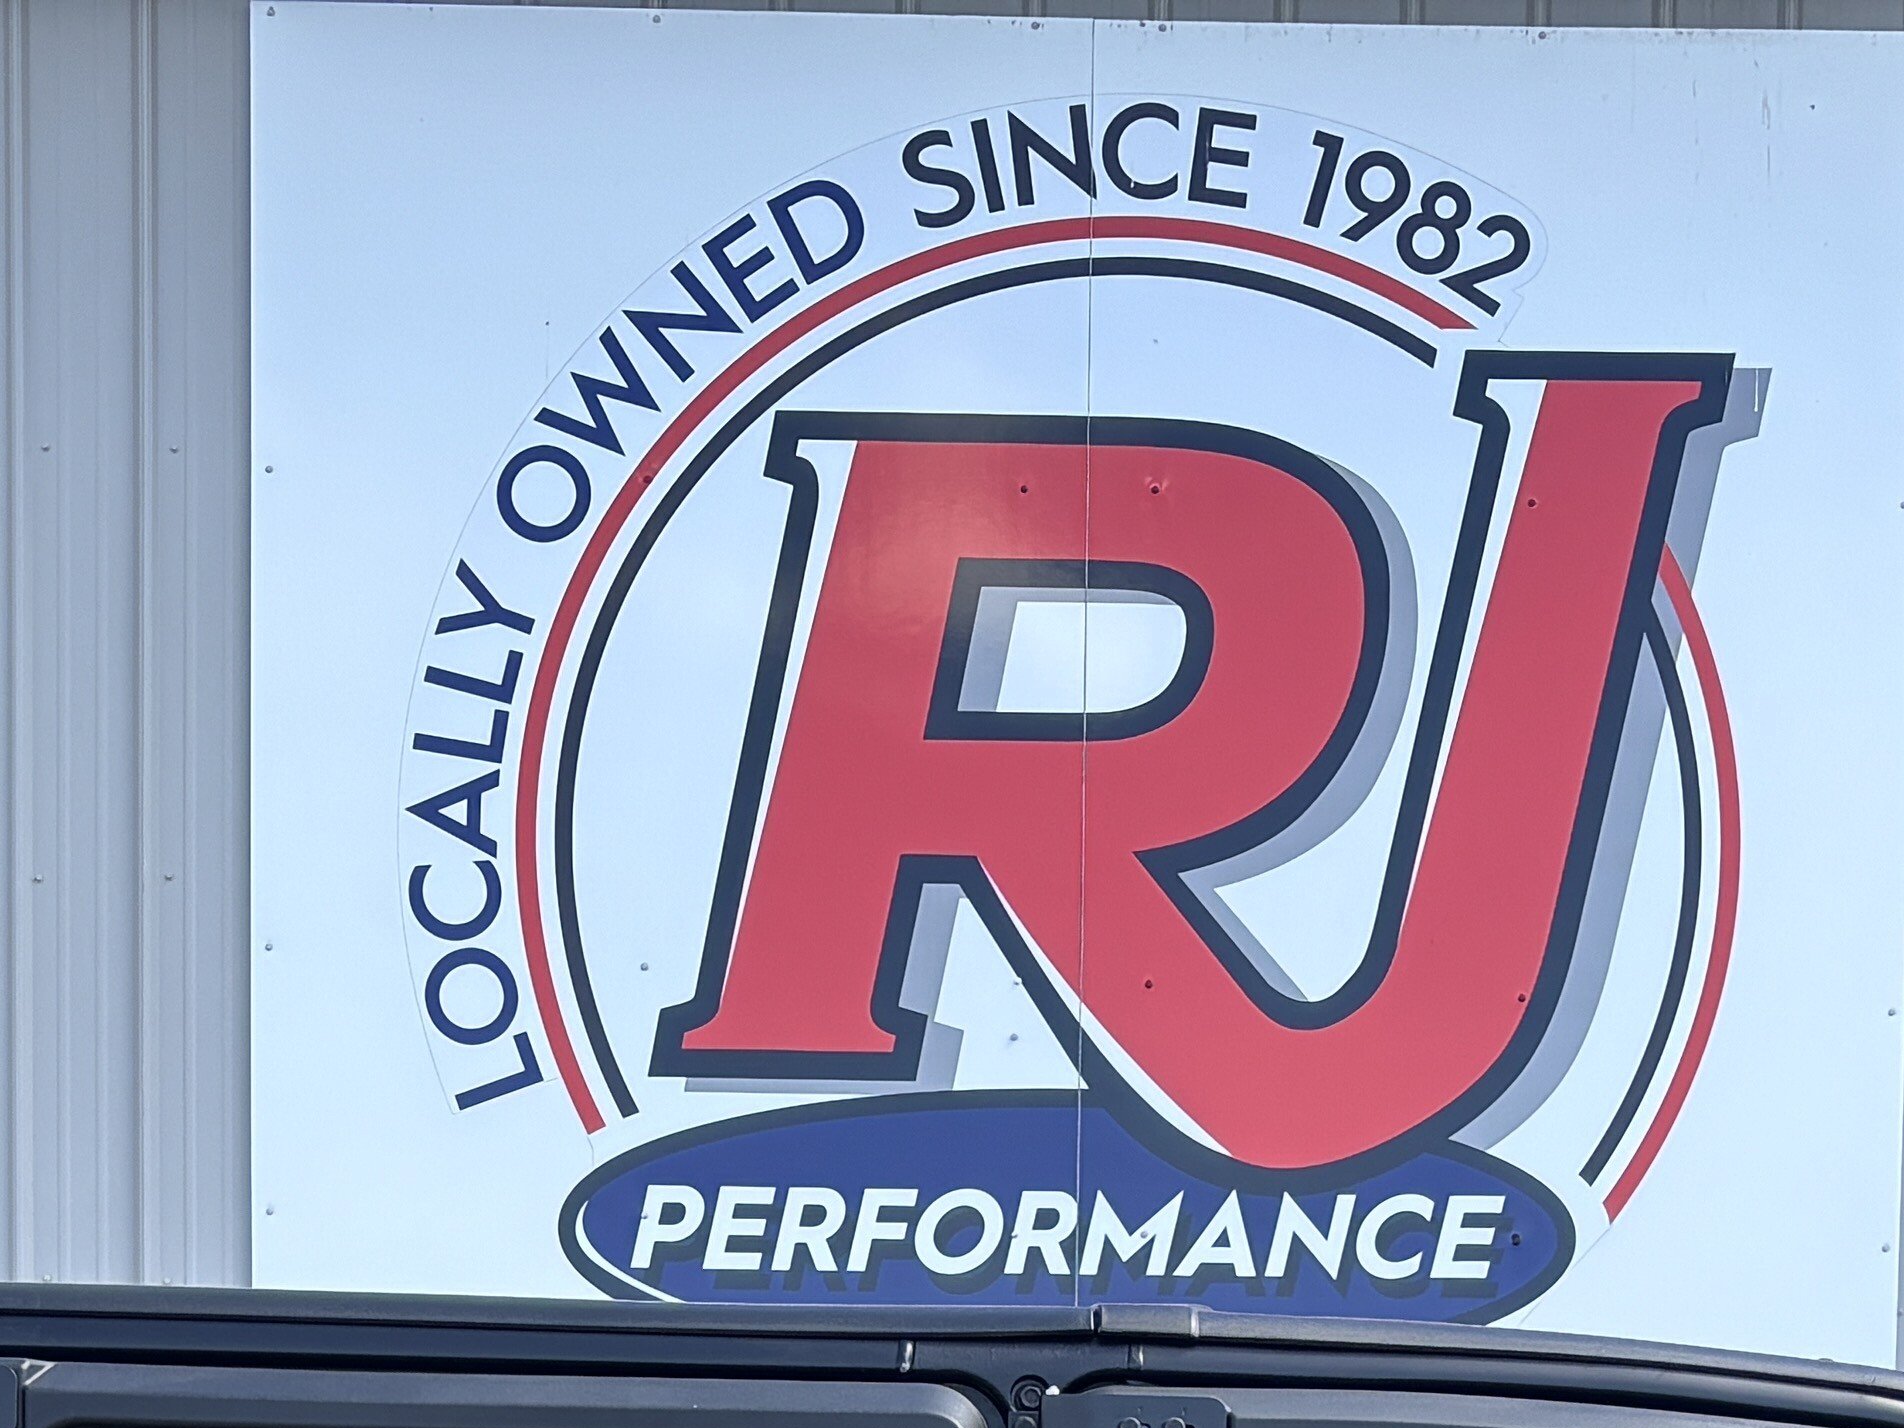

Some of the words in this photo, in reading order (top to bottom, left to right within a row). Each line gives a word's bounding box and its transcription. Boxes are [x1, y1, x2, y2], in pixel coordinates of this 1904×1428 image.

[404, 557, 545, 1112] LOCALLY
[495, 178, 866, 544] OWNED
[900, 101, 1259, 230] SINCE
[1301, 128, 1532, 319] 1982
[648, 351, 1737, 1190] RJ
[629, 1183, 1508, 1283] PERFORMANCE
